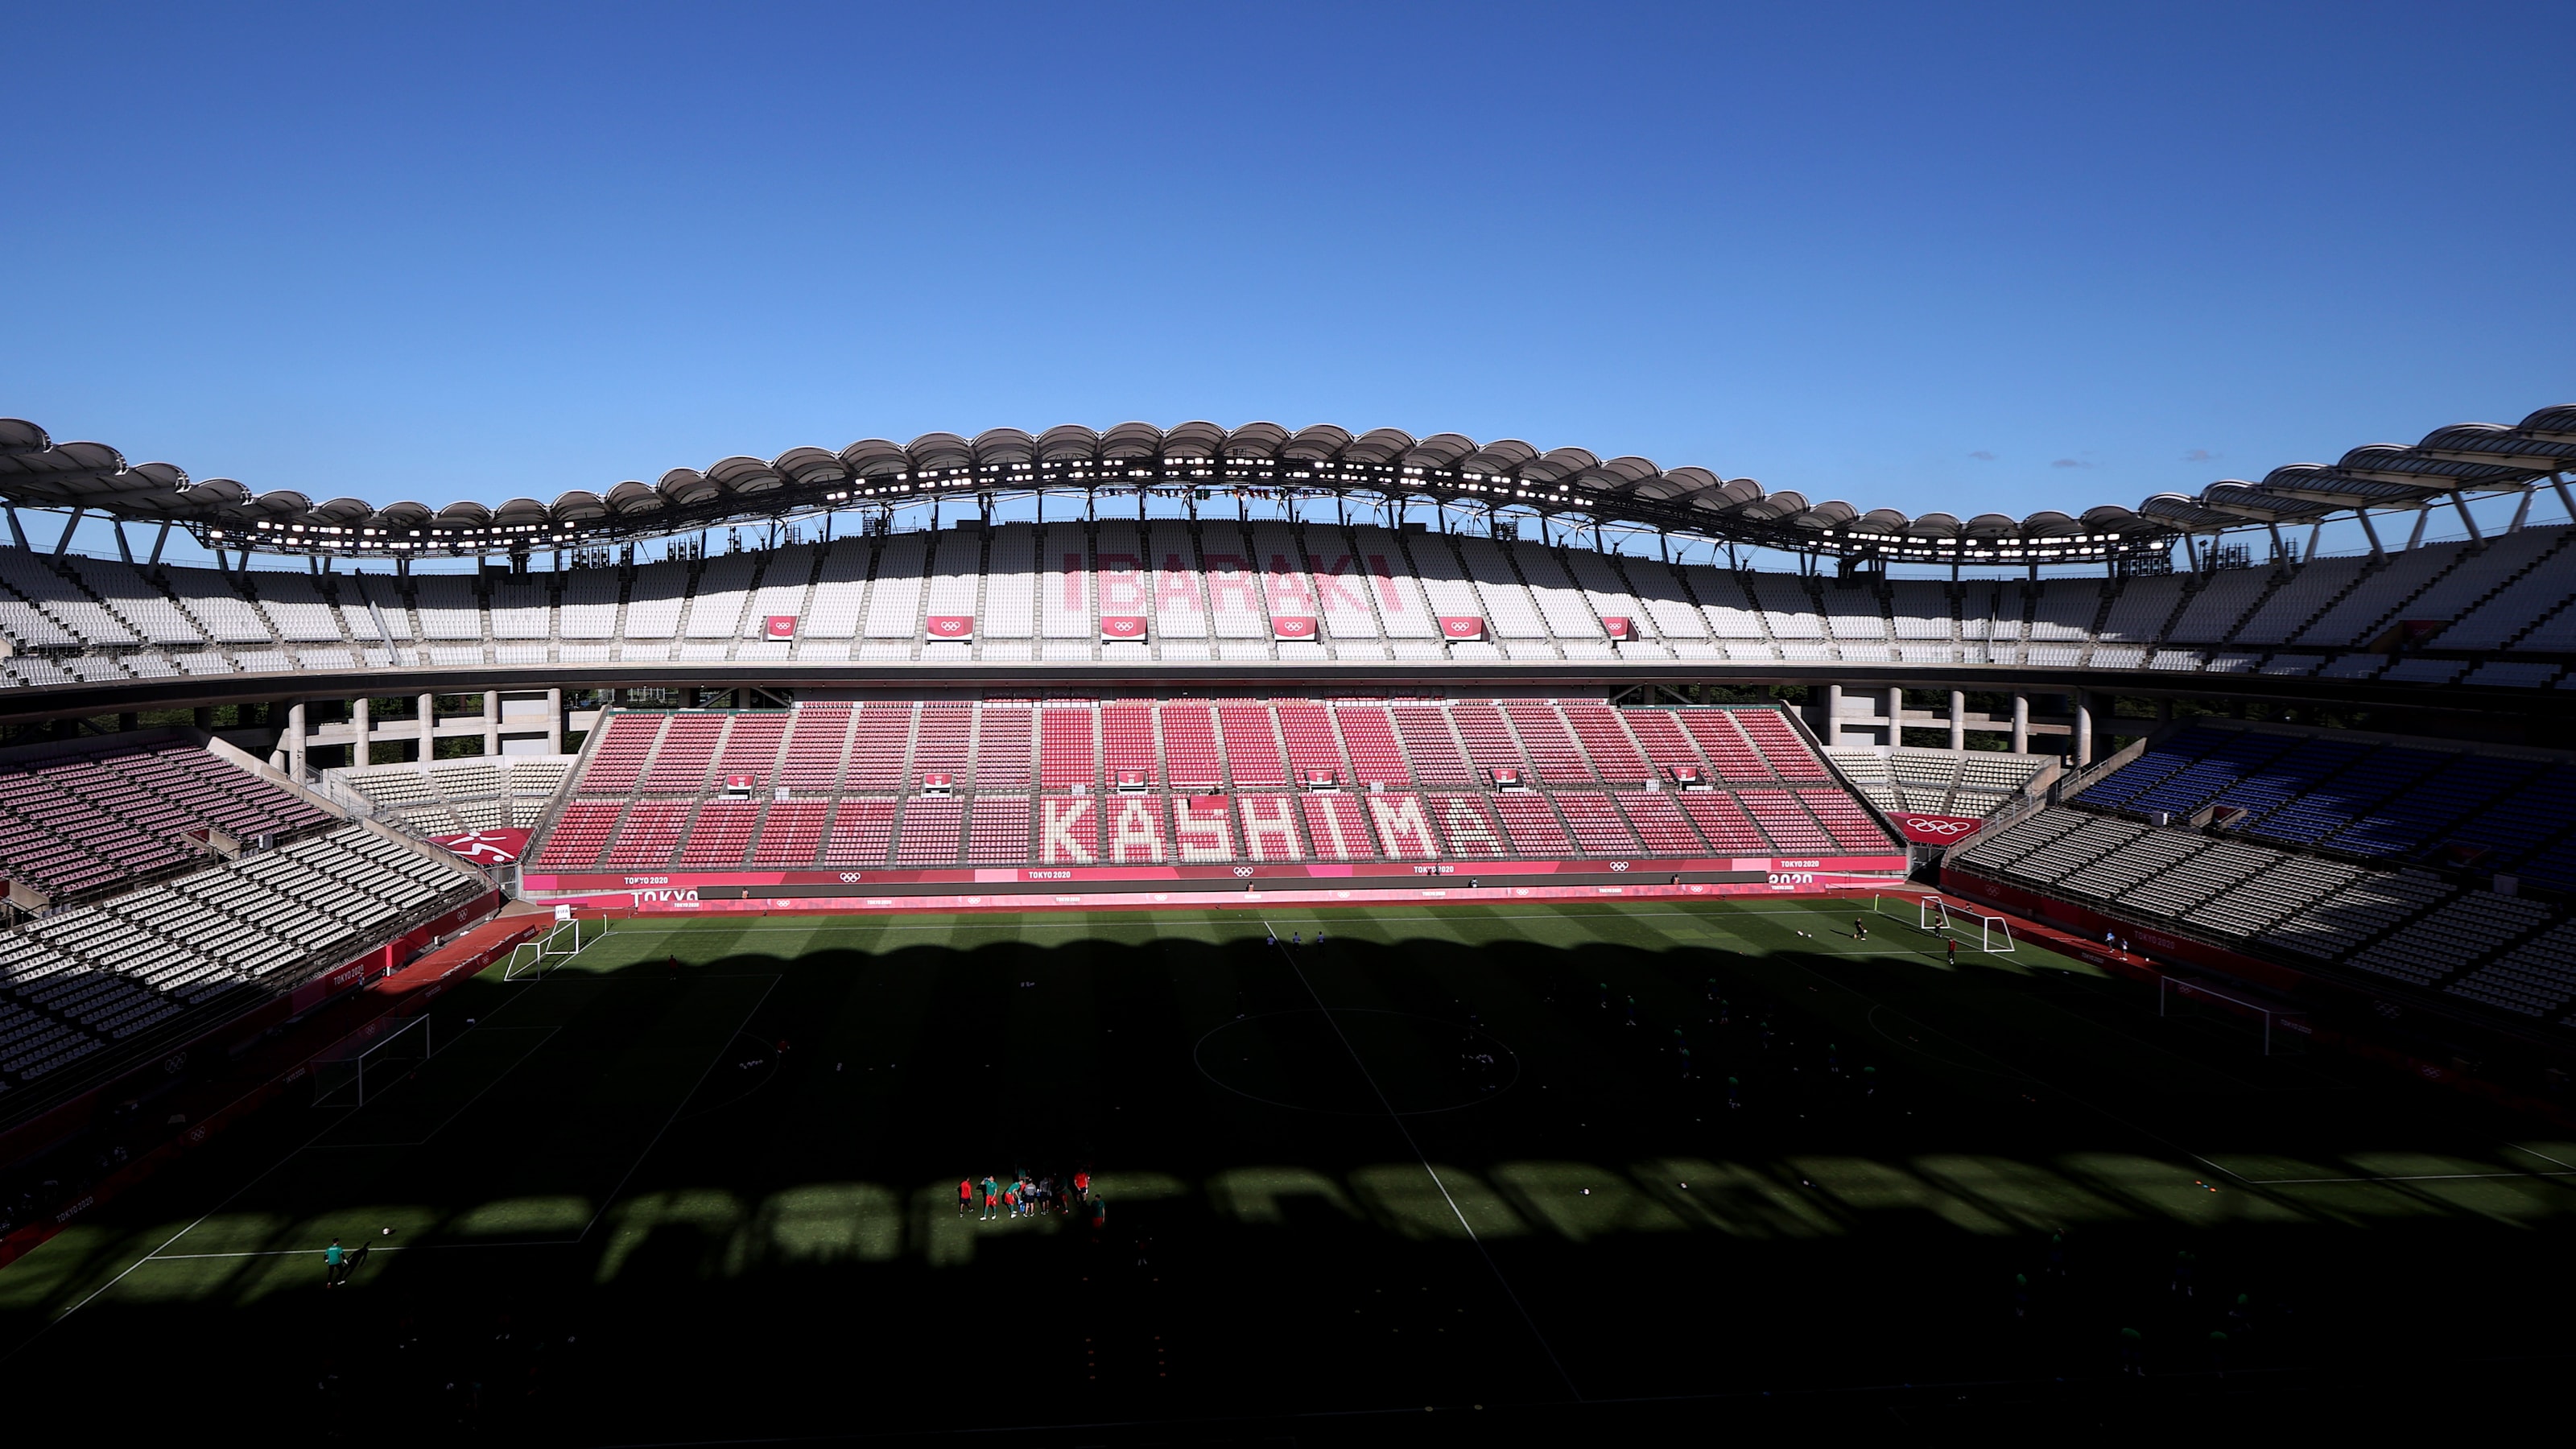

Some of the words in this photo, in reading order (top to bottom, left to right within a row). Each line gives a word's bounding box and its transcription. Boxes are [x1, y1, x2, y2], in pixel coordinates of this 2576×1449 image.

[1063, 553, 1403, 612] IBARAKI
[1042, 795, 1507, 860] KASHIMA
[624, 877, 649, 885] TOKYO
[650, 876, 668, 885] 2020
[1028, 871, 1052, 879] TOKYO
[2134, 930, 2157, 945] TOKYO
[2157, 937, 2176, 949] 2020
[333, 970, 352, 986] TOKYO
[351, 964, 365, 978] 2020
[56, 1205, 78, 1224] TOKYO
[77, 1195, 94, 1211] 2020
